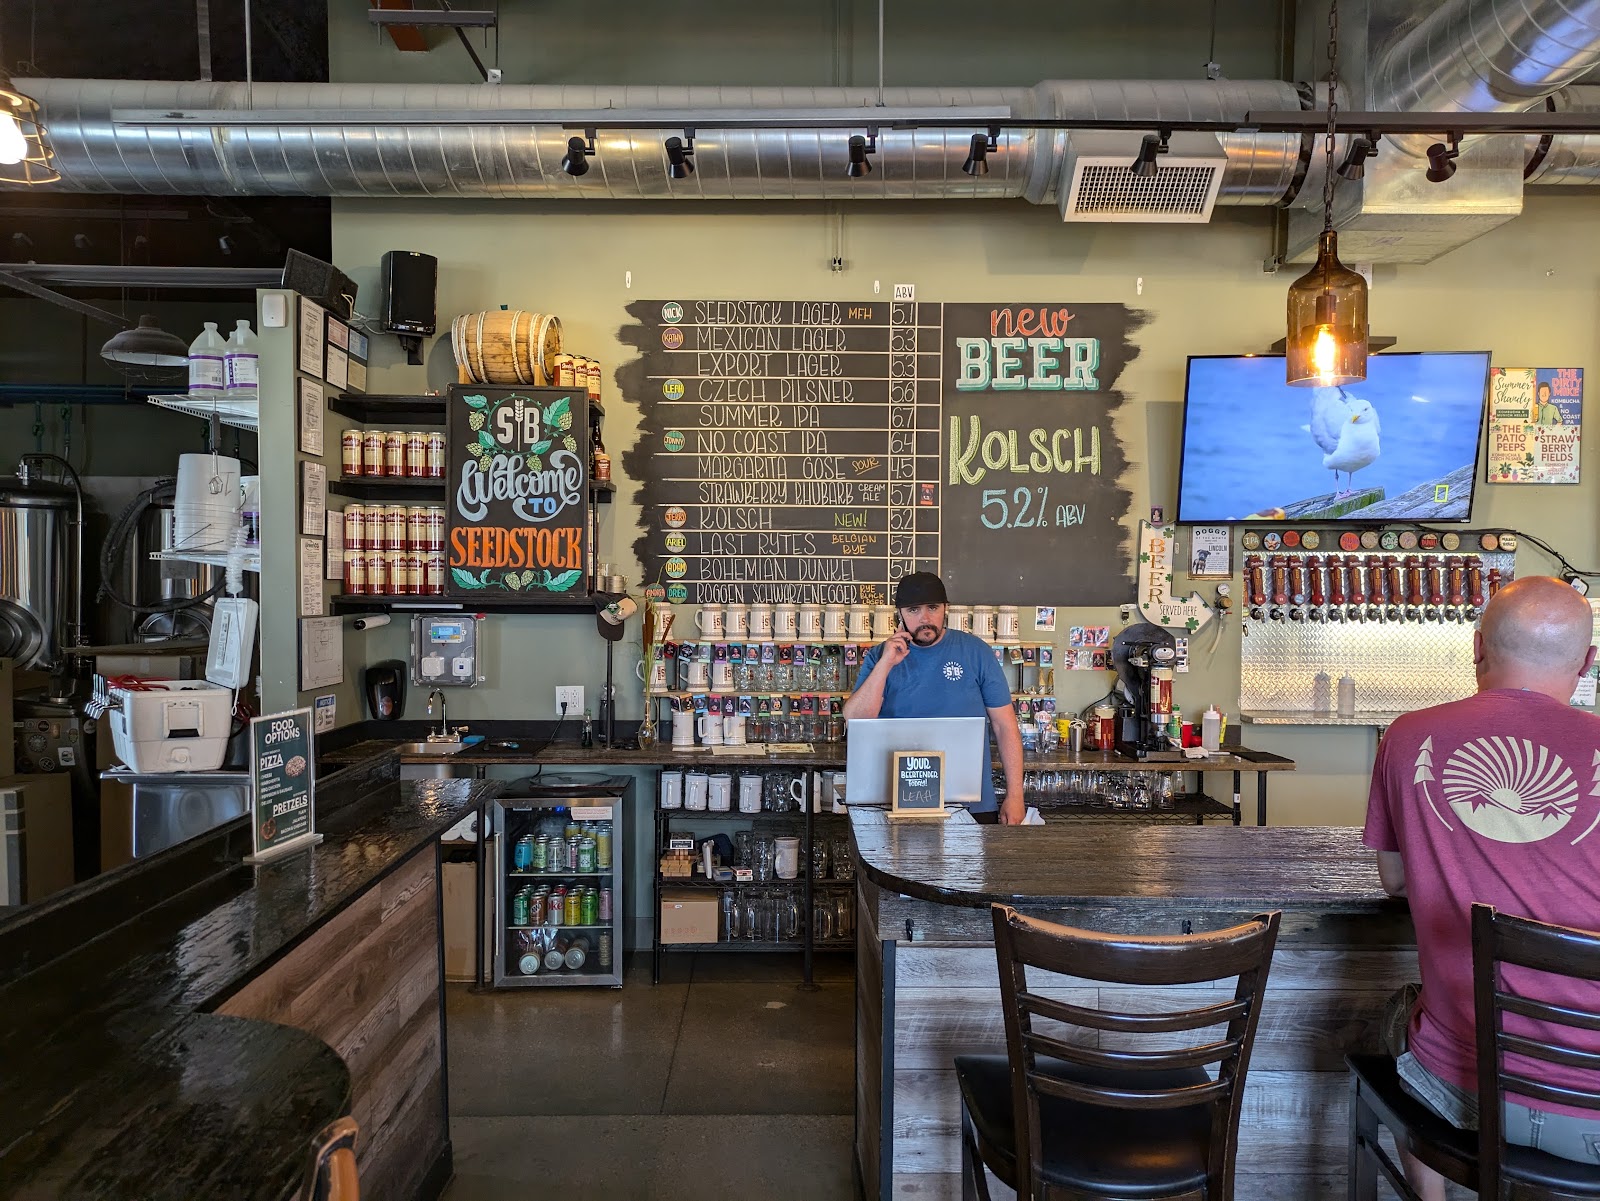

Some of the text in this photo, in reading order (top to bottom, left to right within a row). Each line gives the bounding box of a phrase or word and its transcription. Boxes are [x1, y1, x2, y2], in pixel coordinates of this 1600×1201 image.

[896, 286, 912, 298] ABV
[664, 308, 682, 318] NICK
[695, 301, 872, 324] SEEDSTOCK LAGER MFH
[892, 303, 914, 324] 5.1
[991, 308, 1076, 337] new
[697, 328, 846, 351] MEXICAN LAGER
[892, 328, 916, 352] 5.3
[698, 353, 842, 376] EXPORT LAGER
[892, 354, 916, 378] 5.3
[956, 338, 1100, 390] BEER
[1557, 369, 1577, 378] THE
[664, 384, 683, 393] LEAH
[698, 380, 854, 402] CZECH PILSNER
[892, 382, 915, 403] 5.6
[1495, 377, 1532, 390] Summer
[1552, 378, 1582, 388] DIRTY
[1554, 388, 1580, 396] MIKE
[1494, 388, 1532, 408] Shandy
[699, 406, 820, 427] SUMMER IPA
[892, 407, 914, 428] 6.7
[1496, 434, 1526, 442] PATIO
[1502, 425, 1521, 433] THE
[1540, 434, 1576, 443] STRAW
[698, 431, 828, 453] NO COAST IPA
[891, 432, 914, 453] 6.4
[949, 414, 1100, 486] KOLSCH
[1497, 443, 1526, 451] PEEPS
[1542, 444, 1574, 452] BERRY
[698, 456, 879, 480] MARGARITA GOSE SOUR
[891, 456, 913, 480] 4.5
[1542, 453, 1574, 462] FIELDS
[457, 450, 583, 522] Welcome
[699, 482, 886, 505] STRAWBERRY RHUBARB CREAM
[890, 484, 914, 506] 5.7
[528, 497, 556, 514] TO
[862, 492, 880, 502] ALE
[980, 486, 1086, 529] 5.2% ABV
[700, 506, 868, 530] KOLSCH NEW!
[890, 508, 914, 530] 5.2
[666, 538, 686, 546] ARIEL
[1196, 528, 1226, 536] DOGGO
[450, 526, 582, 569] SEEDSTOCK
[700, 532, 876, 556] LAST RYTES BELGIAN
[842, 544, 867, 554] RYE
[890, 534, 914, 556] 5.7
[666, 562, 686, 572] ADAM
[700, 559, 860, 582] BOHEMIAN DUNKEL
[1148, 538, 1166, 604] BEER
[668, 587, 687, 598] DREW
[696, 583, 875, 604] ROGGEN SCHWARZENEGGER RYE
[1160, 604, 1198, 616] SERVED HERE
[265, 726, 300, 744] OPTIONS
[272, 718, 294, 732] FOOD
[260, 754, 284, 769] PIZZA
[906, 757, 931, 770] YOUR
[273, 794, 308, 815] PRETZELS
[903, 790, 935, 802] LEAH
